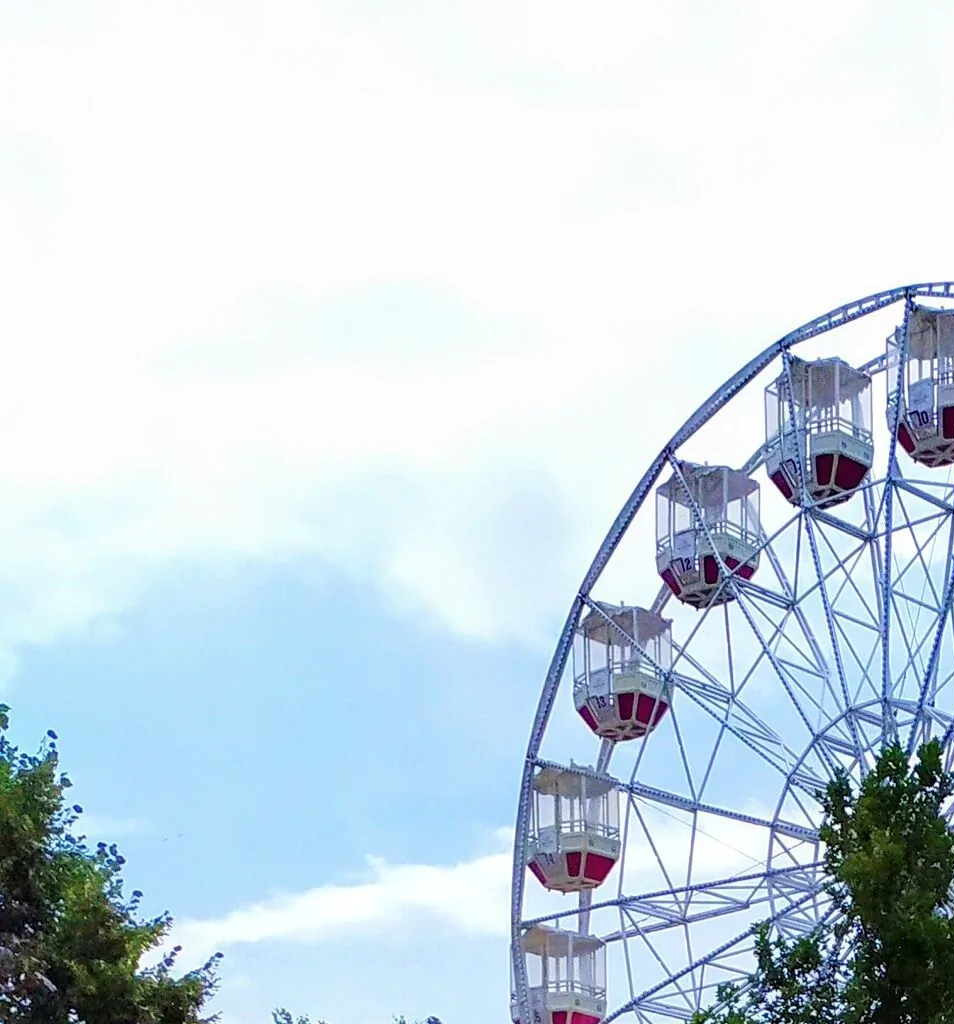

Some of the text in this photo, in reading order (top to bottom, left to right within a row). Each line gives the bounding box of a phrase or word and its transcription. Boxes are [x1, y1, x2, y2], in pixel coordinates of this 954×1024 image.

[917, 410, 930, 427] 10
[681, 558, 692, 573] 12
[595, 695, 607, 709] 13
